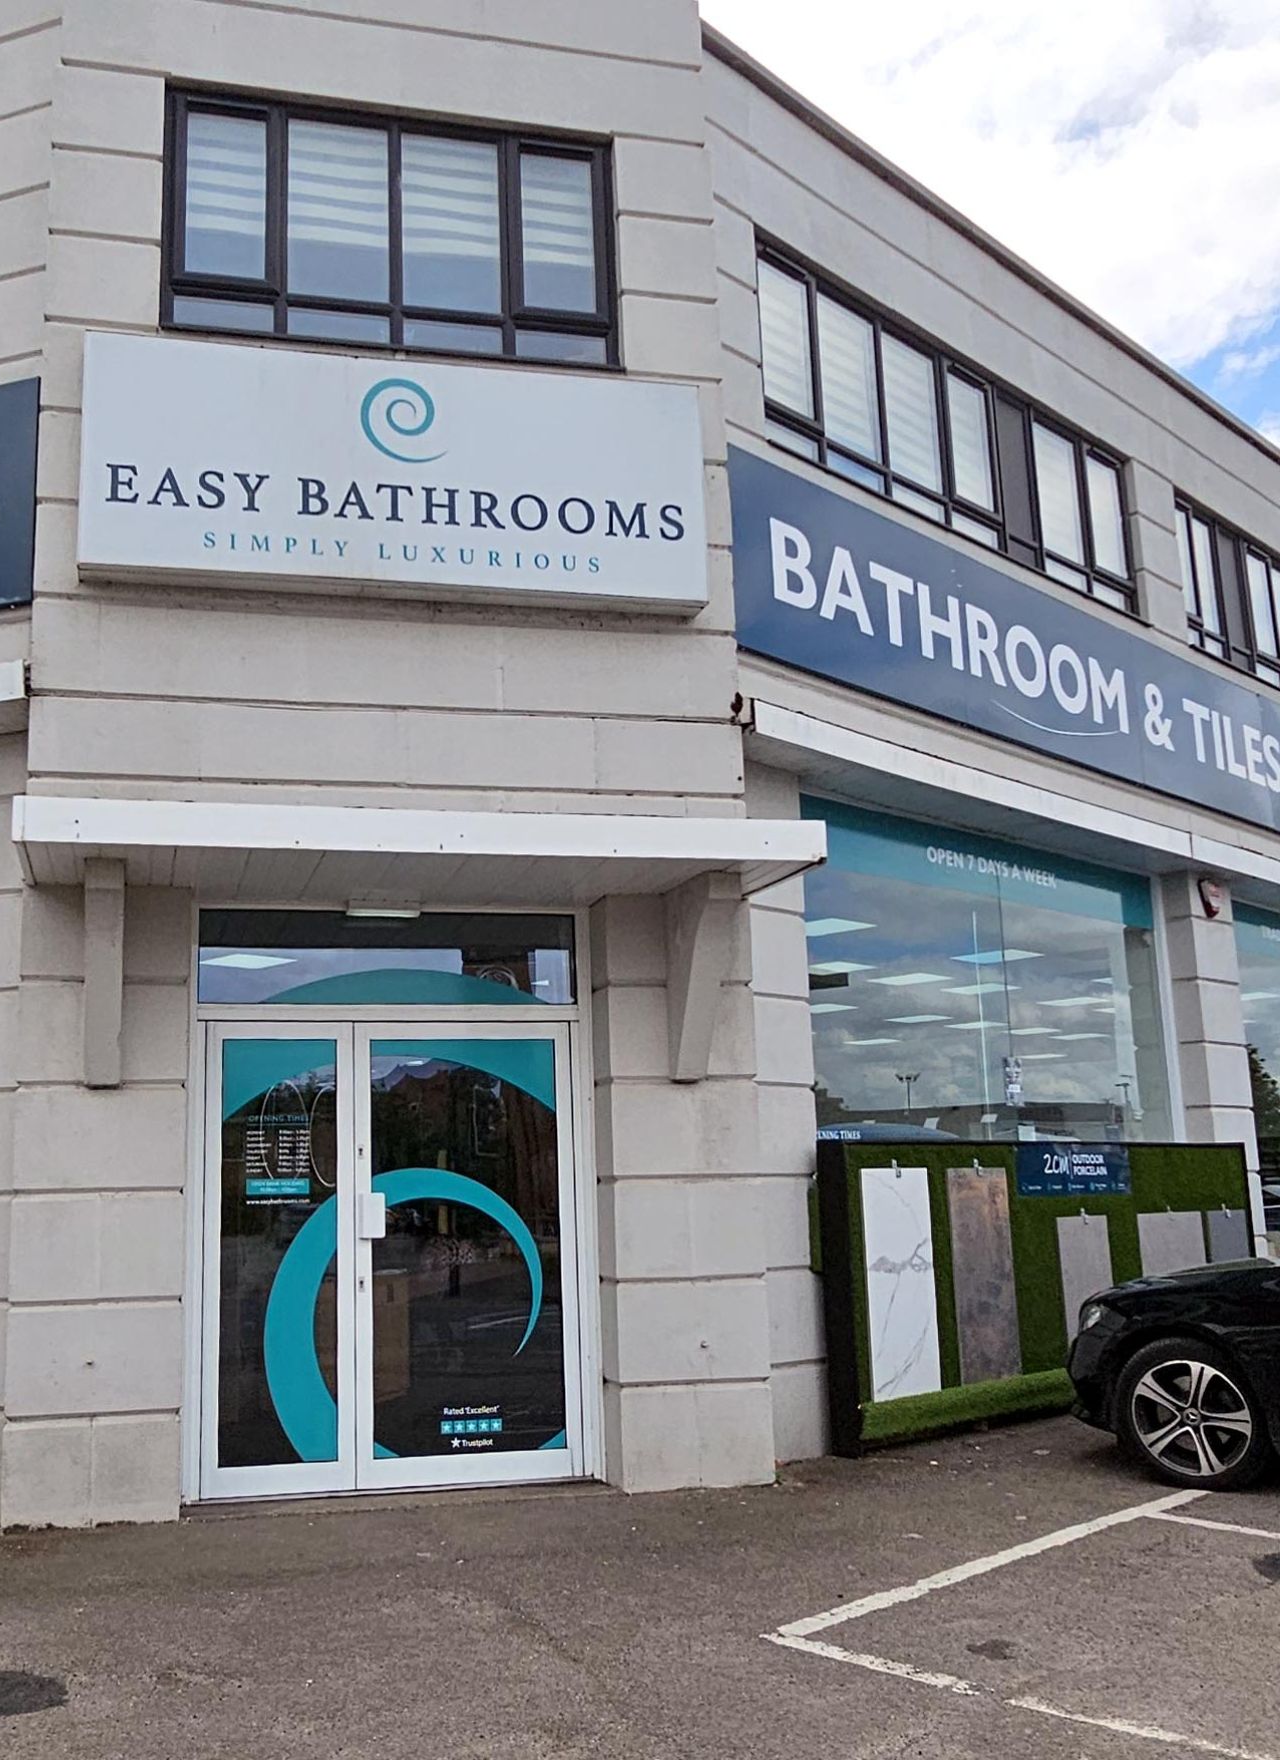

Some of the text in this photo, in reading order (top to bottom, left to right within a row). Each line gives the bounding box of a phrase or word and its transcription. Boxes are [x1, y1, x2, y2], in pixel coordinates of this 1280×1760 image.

[105, 463, 686, 542] EASY BATHROOMS
[203, 531, 602, 574] SIMPLY LUXURIOUS
[768, 516, 1280, 793] BATHROOM & TILES
[926, 846, 1057, 889] OPEN 7 DAYS A WEEK
[1072, 1154, 1105, 1164] OUTDOOR
[1073, 1166, 1108, 1176] PORCELAIN
[443, 1406, 464, 1415] Rated
[462, 1438, 493, 1448] Trustpilot
